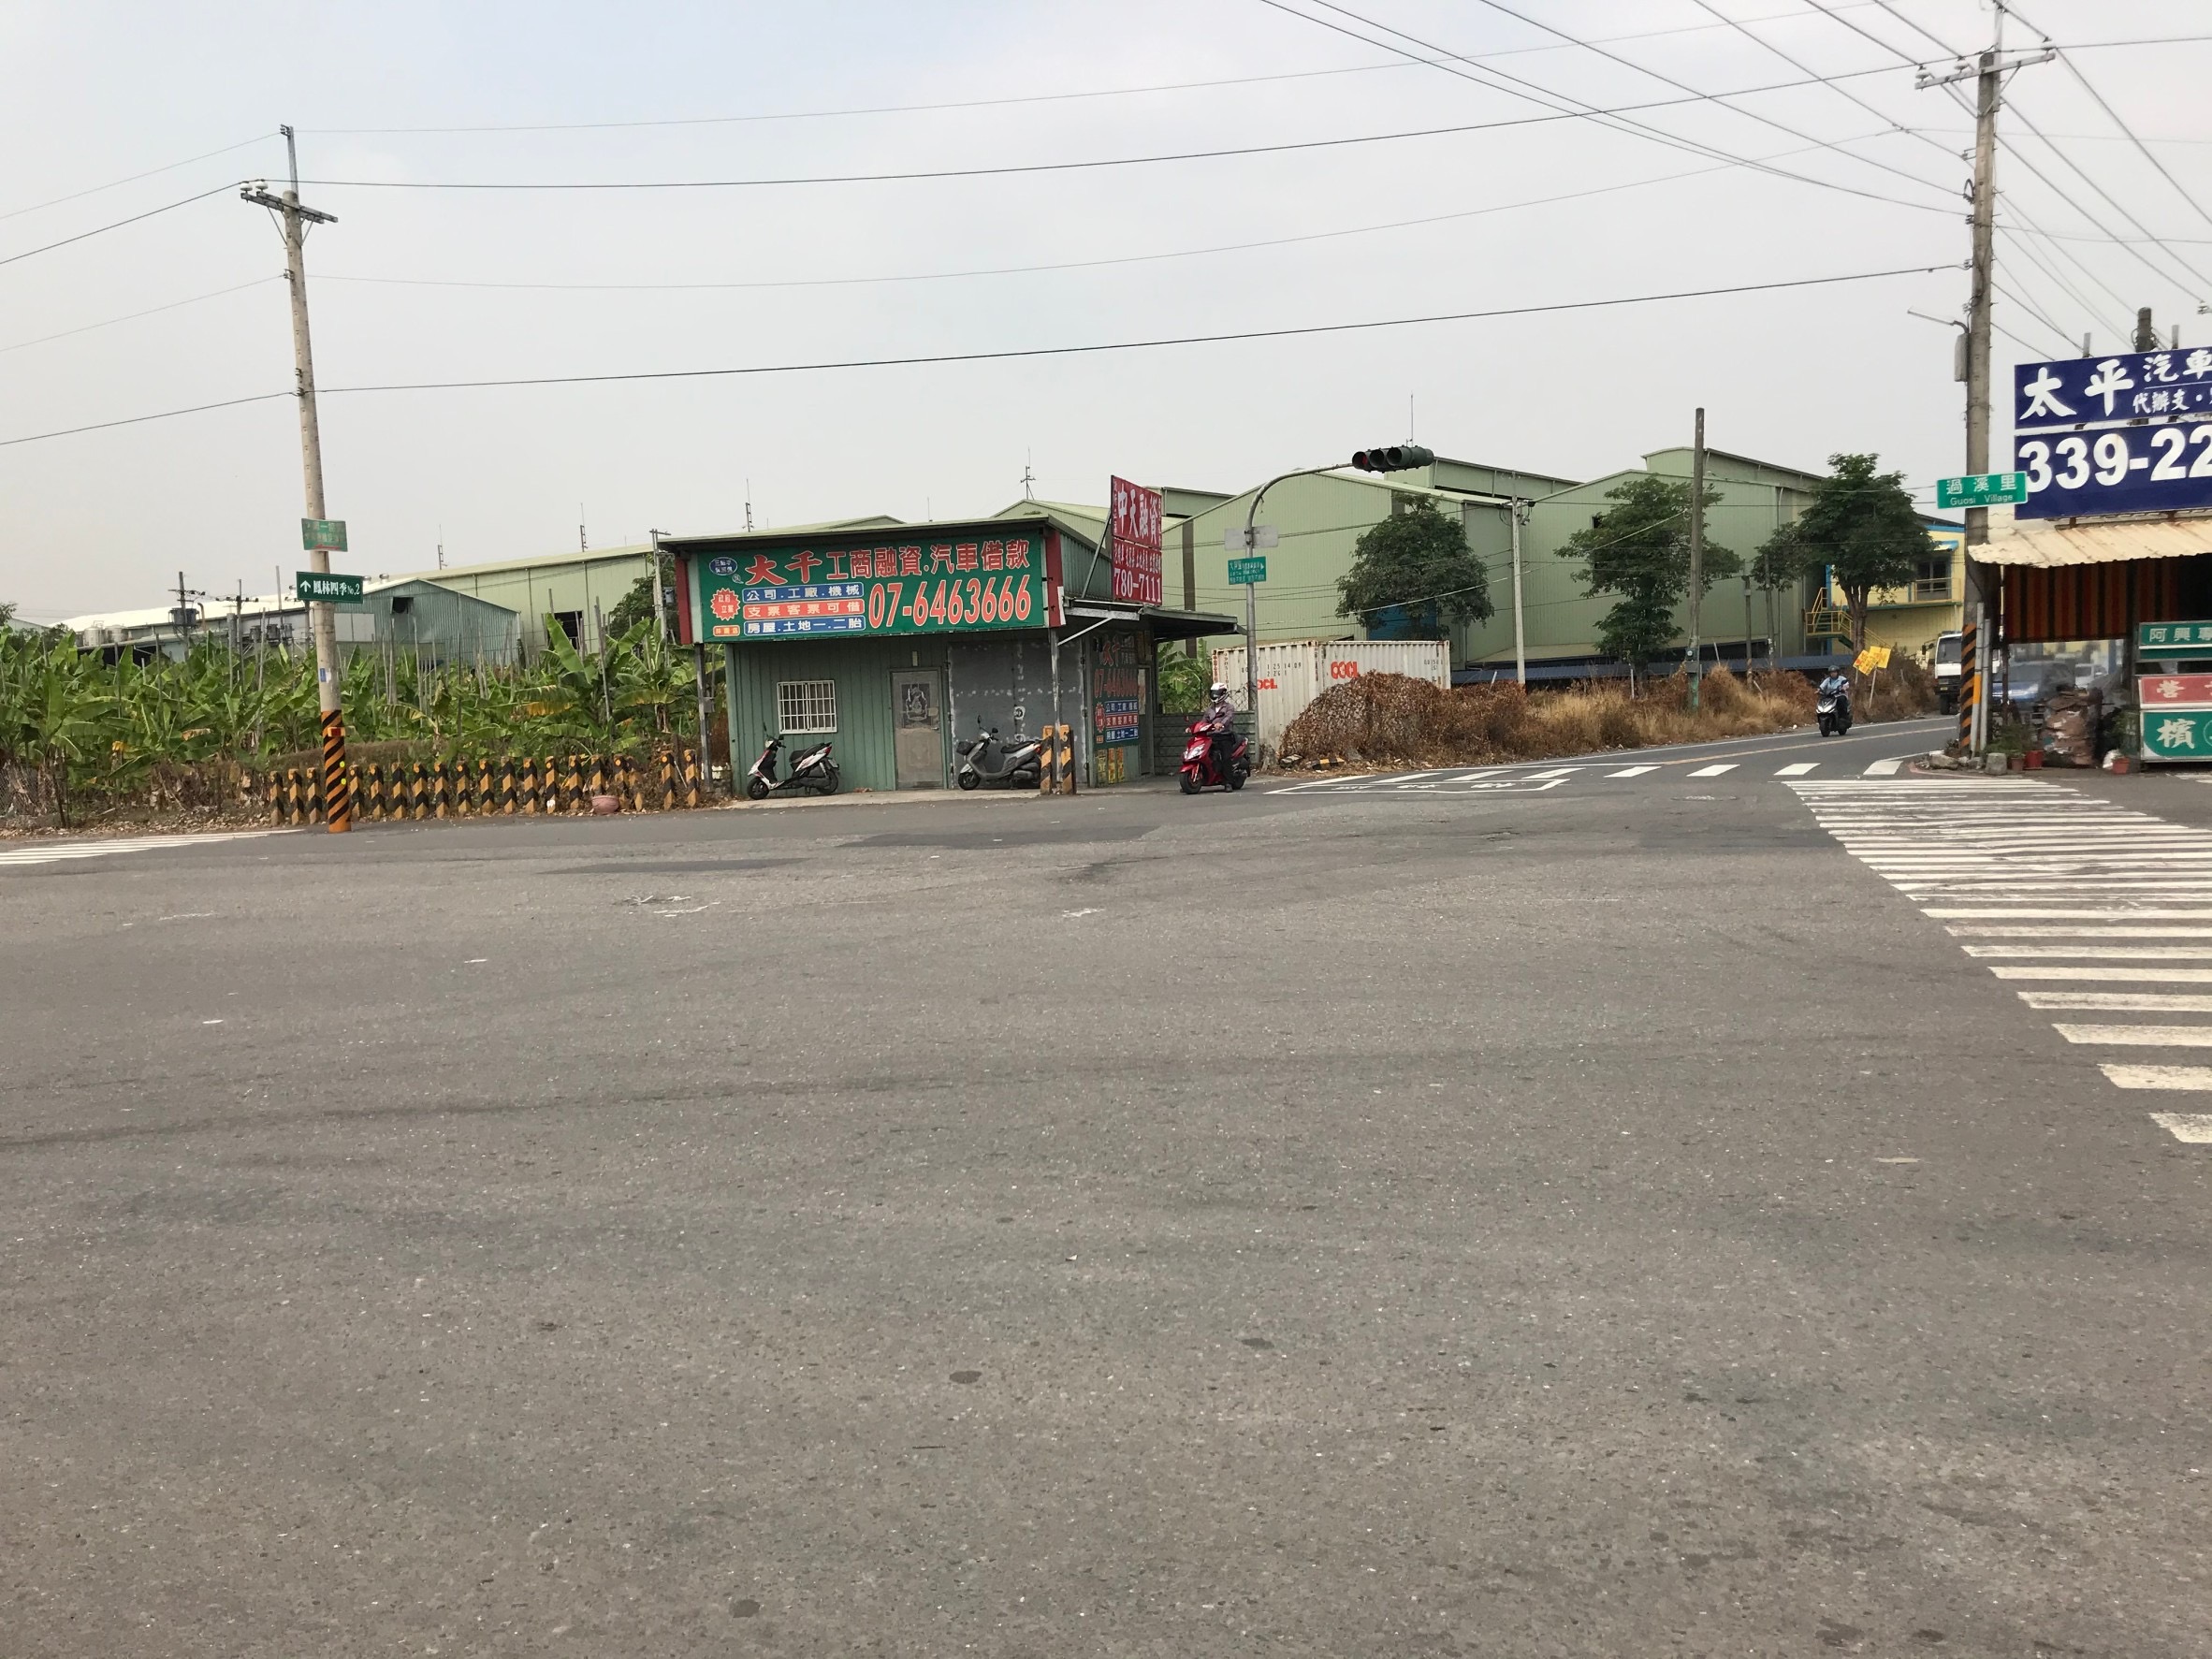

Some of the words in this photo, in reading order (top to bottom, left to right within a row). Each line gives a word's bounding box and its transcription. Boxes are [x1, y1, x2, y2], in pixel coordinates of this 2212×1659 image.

[2019, 359, 2134, 419] 太平
[1946, 474, 2017, 495] 過溪里
[1950, 495, 1976, 506] Guosi
[1984, 494, 2014, 503] Village
[868, 574, 1031, 629] 07-6463666
[1113, 567, 1162, 603] 780-7111
